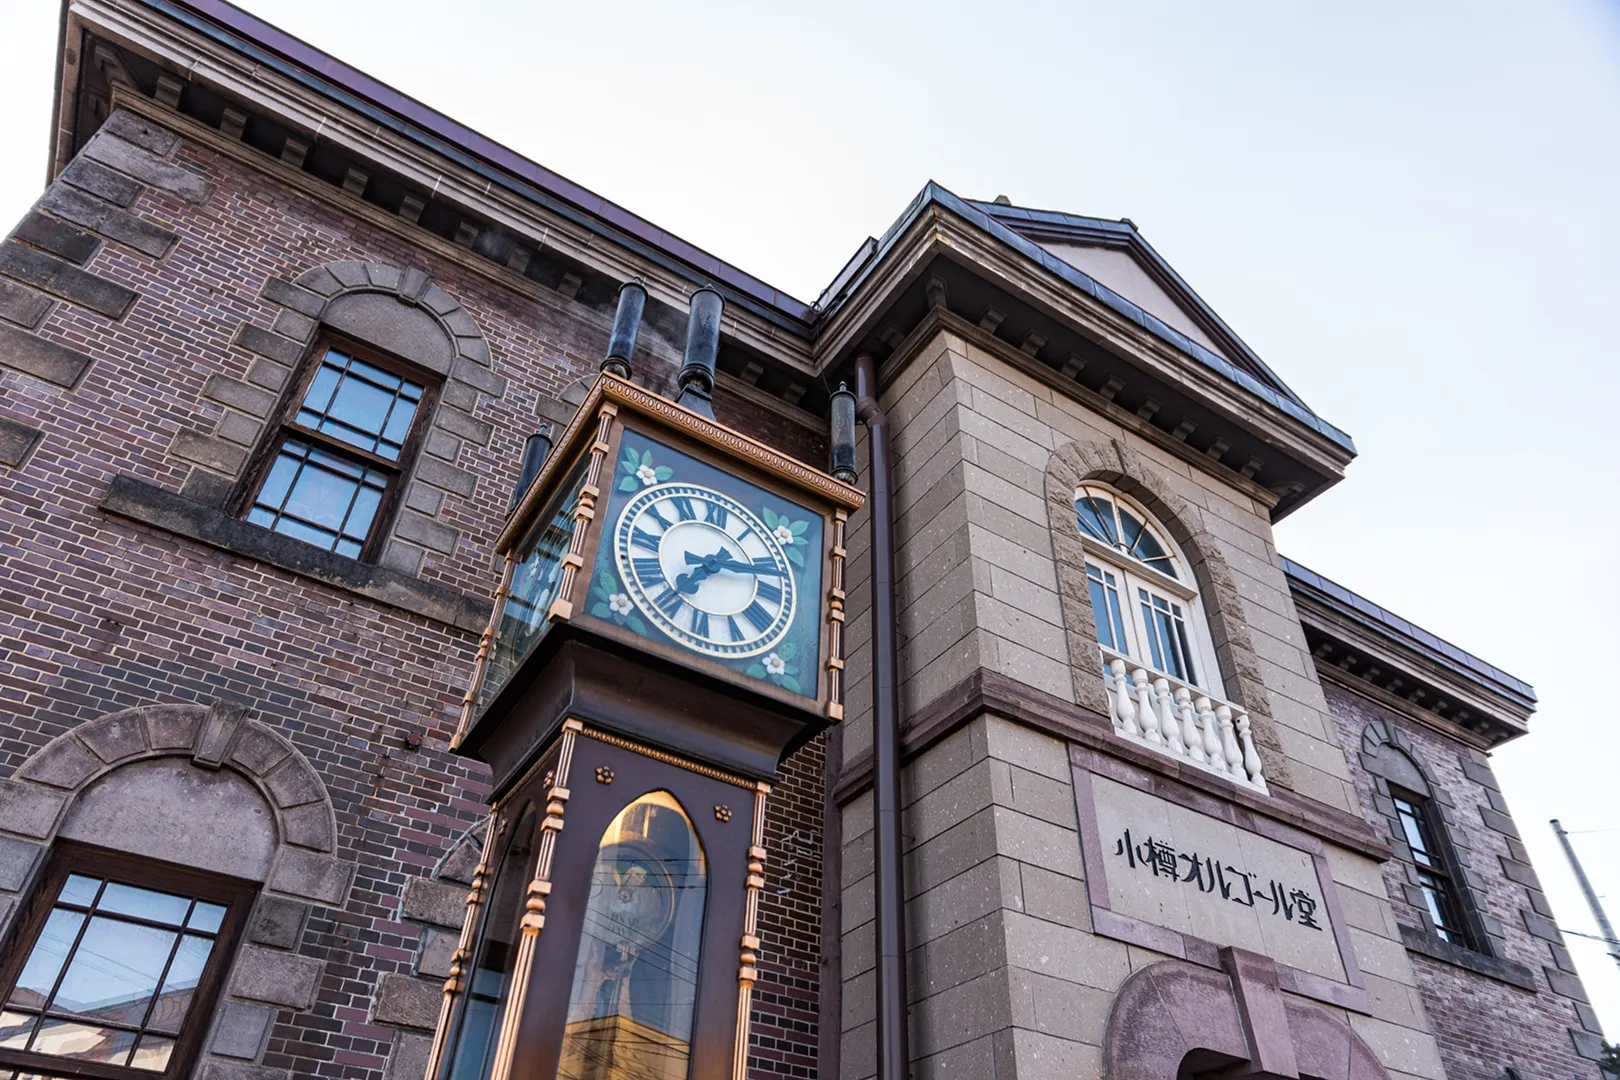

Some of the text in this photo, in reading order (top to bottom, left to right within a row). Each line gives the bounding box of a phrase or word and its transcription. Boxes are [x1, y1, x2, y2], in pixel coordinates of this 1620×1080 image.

[644, 503, 675, 532] X
[671, 496, 698, 521] XI
[704, 500, 728, 530] XII
[631, 525, 662, 553] IX
[737, 526, 754, 543] I
[691, 608, 709, 639] VI
[727, 615, 746, 642] V
[1114, 828, 1323, 932] 小樽オルゴール堂
